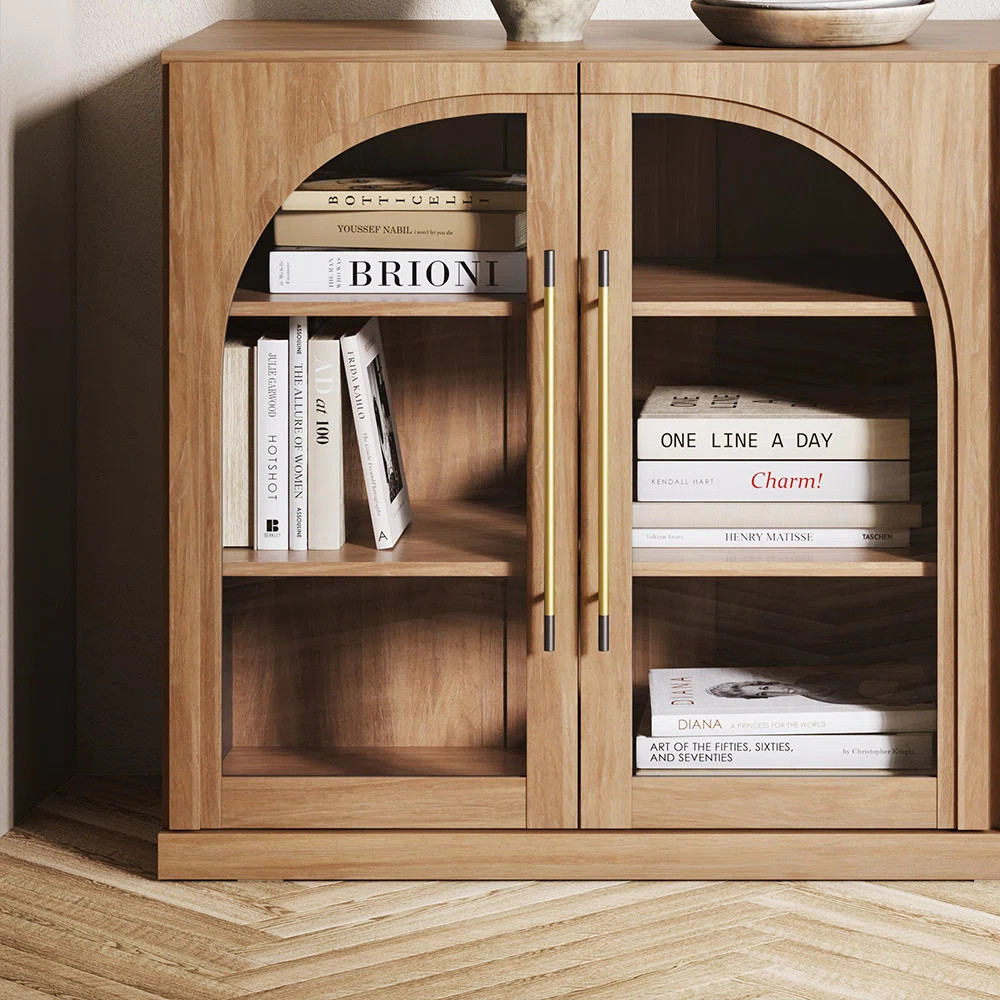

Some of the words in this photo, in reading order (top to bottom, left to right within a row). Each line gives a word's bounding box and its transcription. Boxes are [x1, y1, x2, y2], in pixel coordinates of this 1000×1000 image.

[328, 195, 490, 206] BOTTICELLI
[337, 224, 381, 234] YOUSSEF
[383, 224, 412, 234] NABIL
[349, 260, 499, 287] BRIONI
[268, 353, 277, 376] JULIE
[294, 363, 303, 385] THE
[314, 357, 333, 394] AD
[347, 351, 357, 383] FRIDA
[353, 384, 366, 420] KAHLO
[268, 377, 277, 418] GARWOOD
[316, 398, 328, 414] at
[294, 388, 303, 433] ALLURE
[316, 420, 329, 445] 100
[661, 432, 696, 448] ONE
[712, 432, 758, 448] LINE
[771, 432, 784, 448] A
[796, 432, 833, 448] DAY
[294, 436, 303, 451] OF
[268, 435, 277, 500] HOTSHOT
[294, 454, 303, 499] WOMEN
[751, 472, 823, 489] Charm!
[725, 532, 763, 542] HENRY
[766, 532, 813, 542] MATISSE
[678, 719, 723, 730] DIANA
[737, 721, 769, 729] PRINCESS
[800, 720, 826, 728] WORLD
[650, 742, 670, 752] ART
[673, 742, 690, 752] OF
[692, 742, 712, 752] THE
[715, 742, 752, 753] FIFTIES,
[755, 742, 794, 753] SIXTIES,
[650, 753, 676, 762] AND
[678, 753, 733, 762] SEVENTIES
